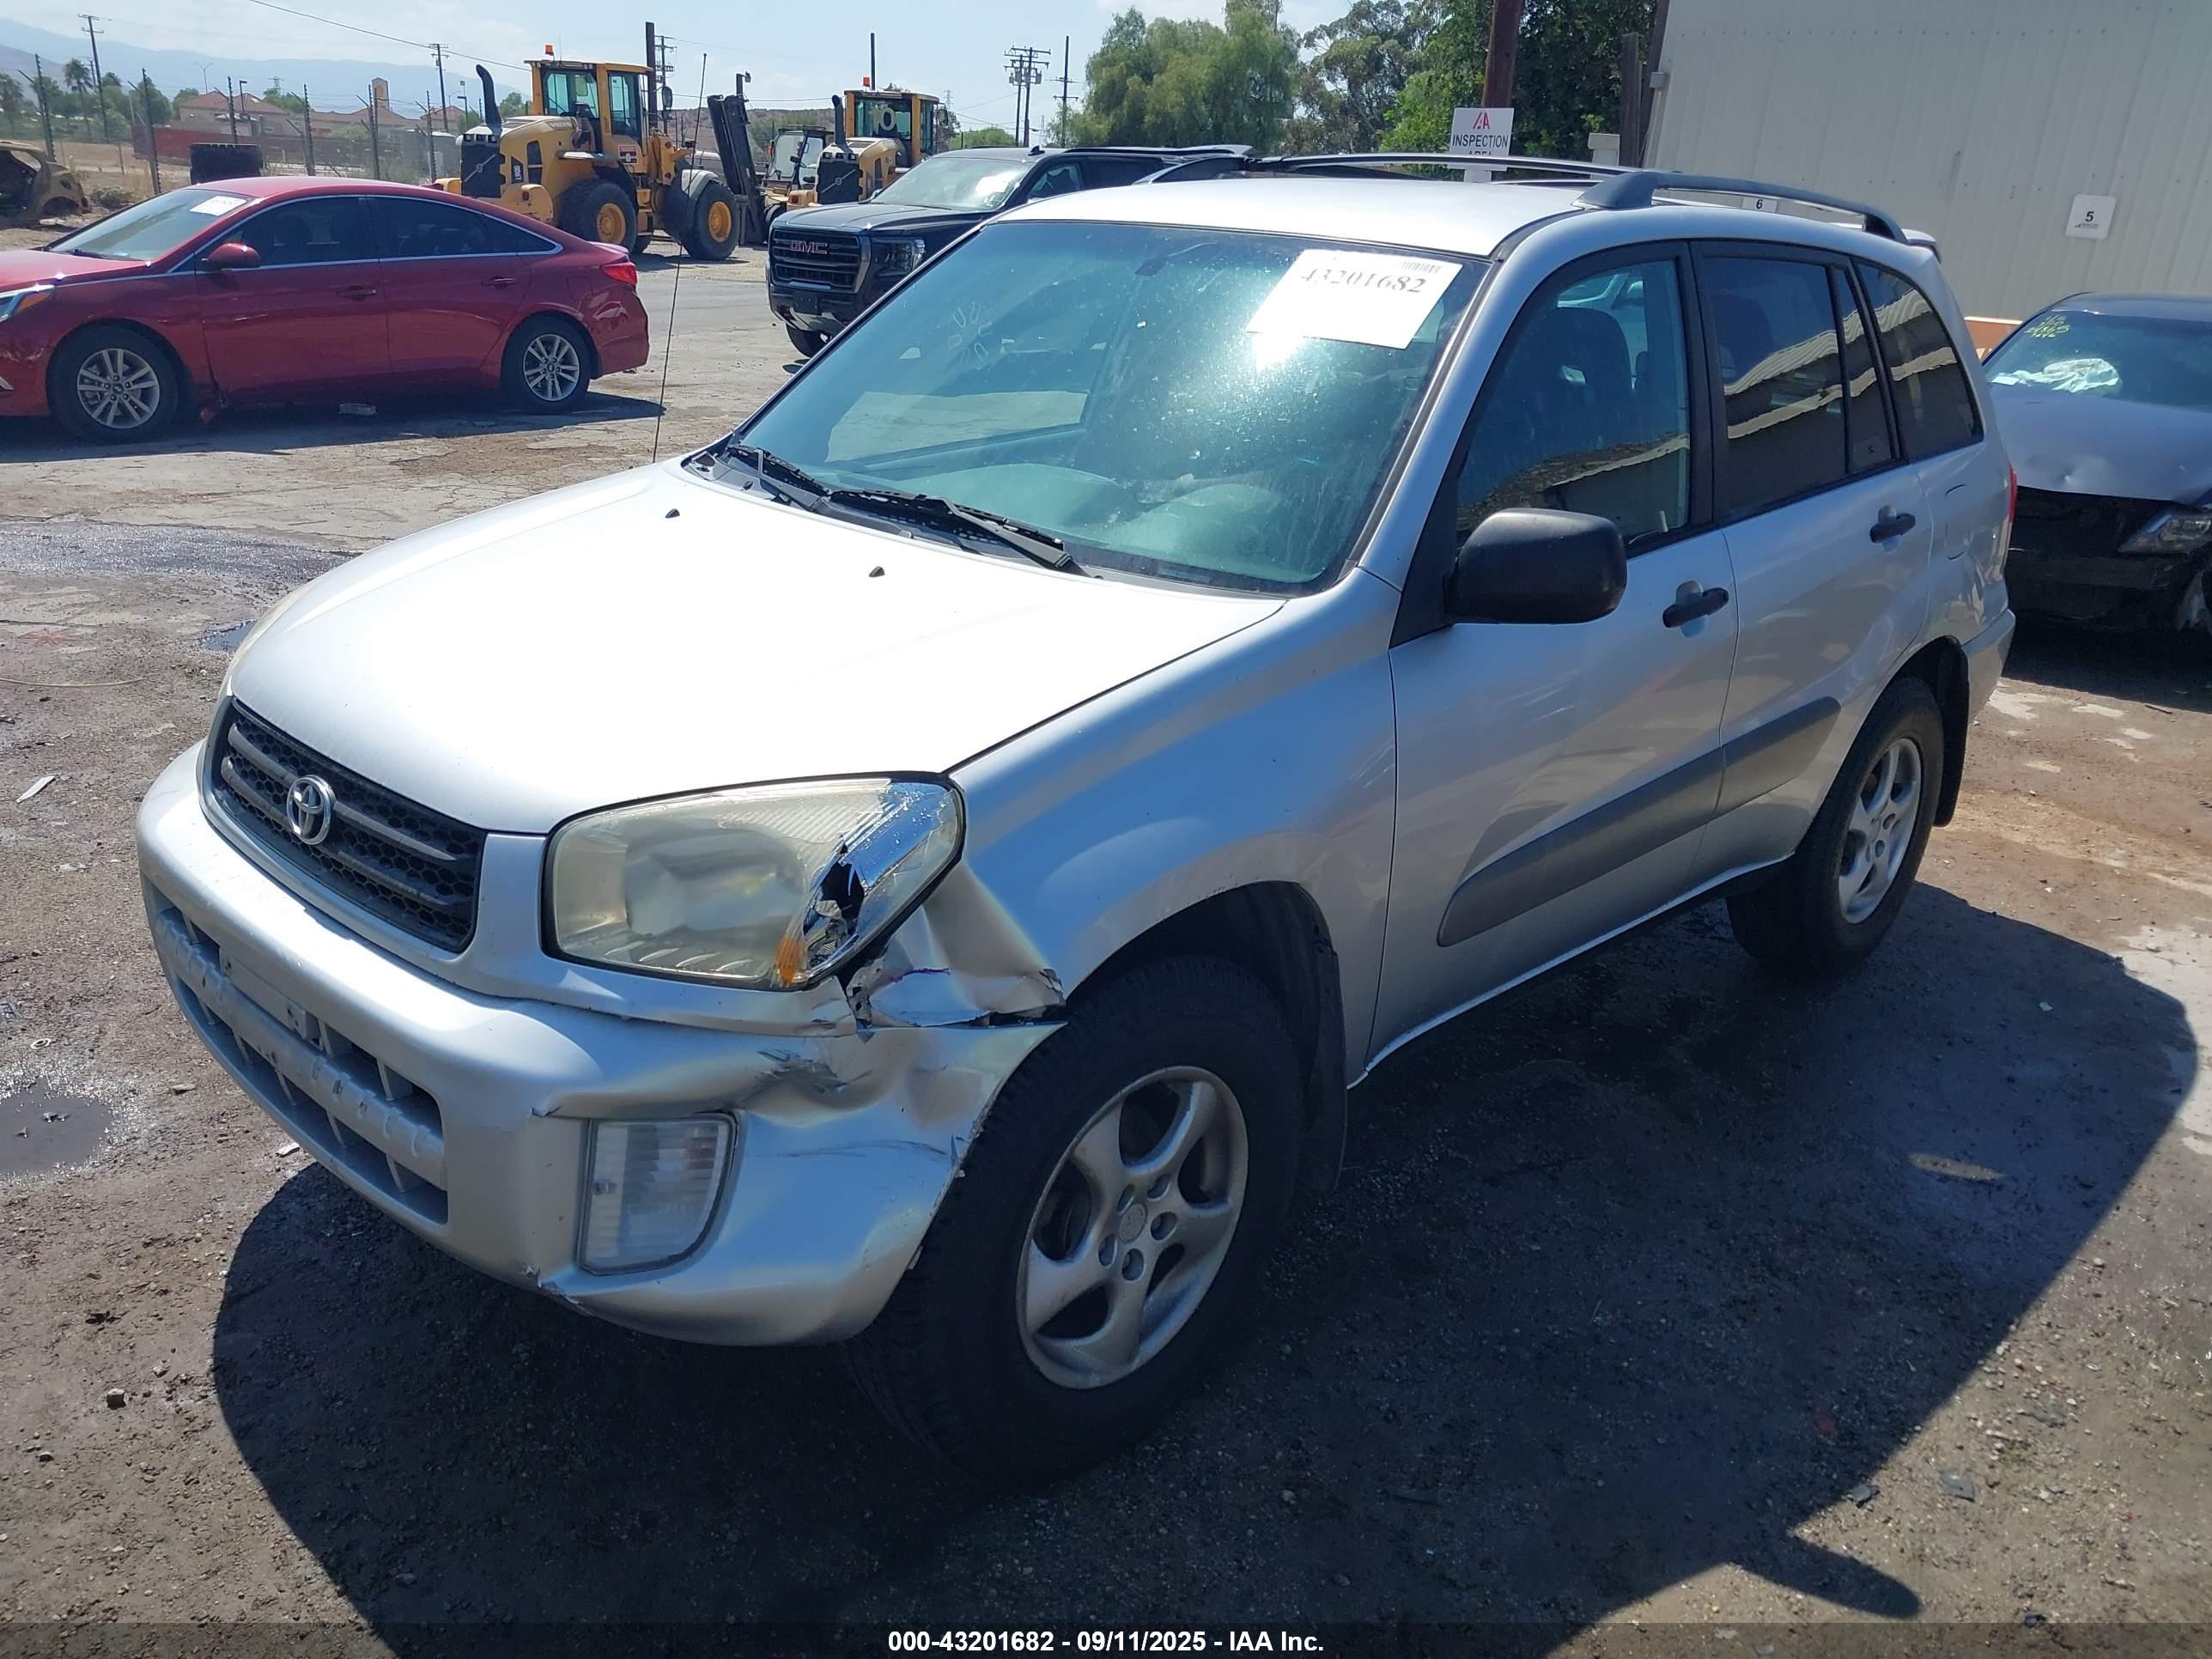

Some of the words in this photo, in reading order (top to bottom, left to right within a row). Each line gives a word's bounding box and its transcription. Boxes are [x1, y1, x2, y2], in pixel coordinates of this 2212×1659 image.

[1453, 134, 1509, 148] INSPECTION
[1756, 198, 1764, 210] 6
[2085, 210, 2095, 222] 5
[789, 240, 827, 255] GMC
